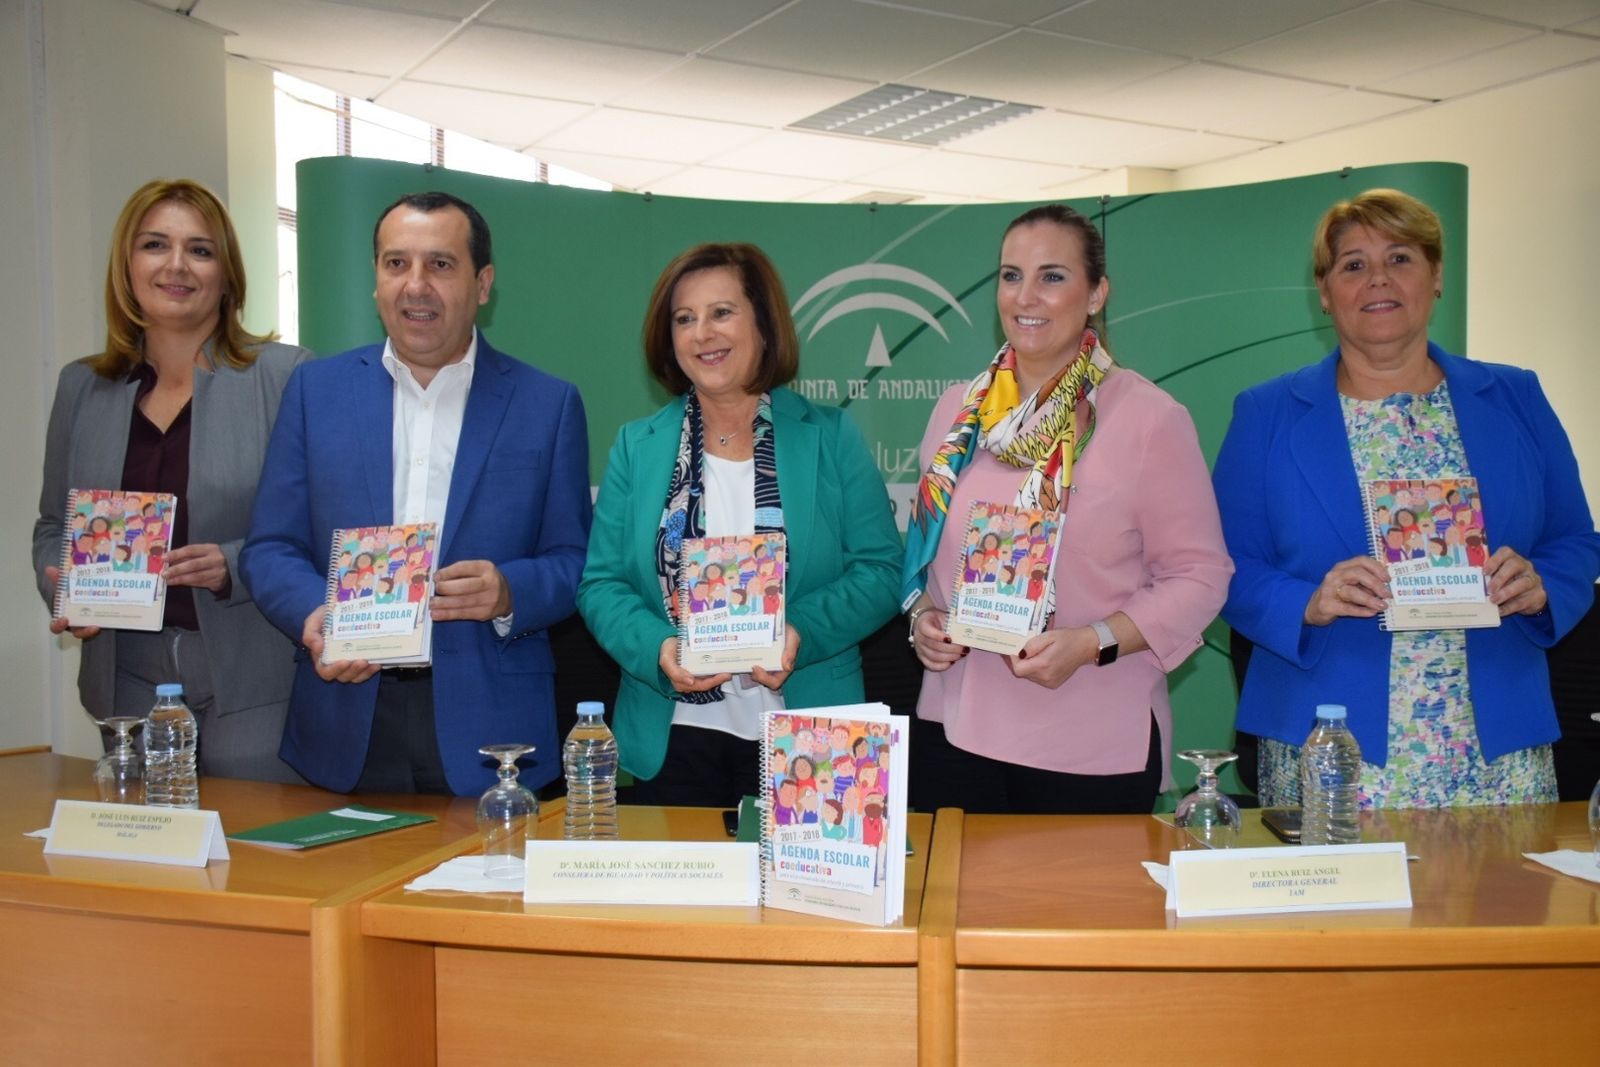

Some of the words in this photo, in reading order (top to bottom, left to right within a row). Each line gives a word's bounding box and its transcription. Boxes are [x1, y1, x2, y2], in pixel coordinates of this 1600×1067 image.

[847, 380, 869, 399] DE
[75, 578, 109, 588] AGENDA
[112, 579, 152, 589] ESCOLAR
[1396, 575, 1433, 586] AGENDA
[1436, 574, 1479, 585] ESCOLAR
[1397, 587, 1446, 597] coeducativa
[963, 596, 993, 610] AGENDA
[994, 602, 1030, 617] ESCOLAR
[339, 612, 372, 623] AGENDA
[374, 609, 412, 621] ESCOLAR
[694, 624, 728, 635] AGENDA
[731, 621, 770, 632] ESCOLAR
[781, 831, 797, 842] 2017
[803, 830, 820, 841] 2018
[780, 844, 820, 862] AGENDA
[823, 850, 870, 869] ESCOLAR
[574, 860, 606, 869] MARÍA
[609, 860, 630, 869] JOSÉ
[780, 859, 832, 876] coeducativa
[1262, 870, 1289, 878] ELENA
[1252, 879, 1298, 888] DIRECTORA
[1300, 878, 1337, 886] GENERAL
